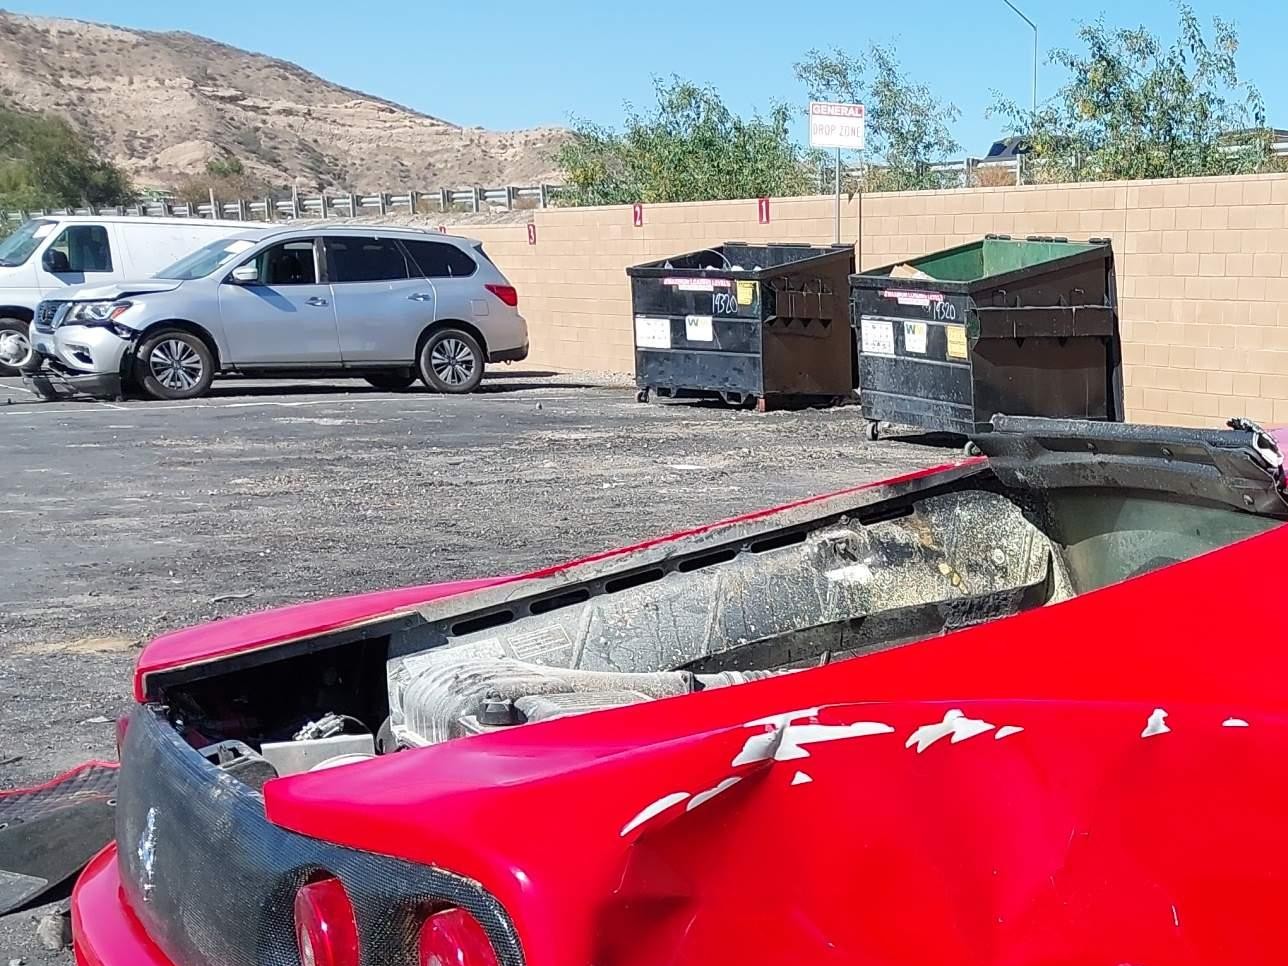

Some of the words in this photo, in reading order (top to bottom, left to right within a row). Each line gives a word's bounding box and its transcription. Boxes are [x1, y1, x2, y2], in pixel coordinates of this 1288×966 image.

[813, 104, 862, 117] GENERAL
[813, 123, 836, 137] DROP
[840, 125, 861, 138] ZONE
[905, 323, 924, 335] WM
